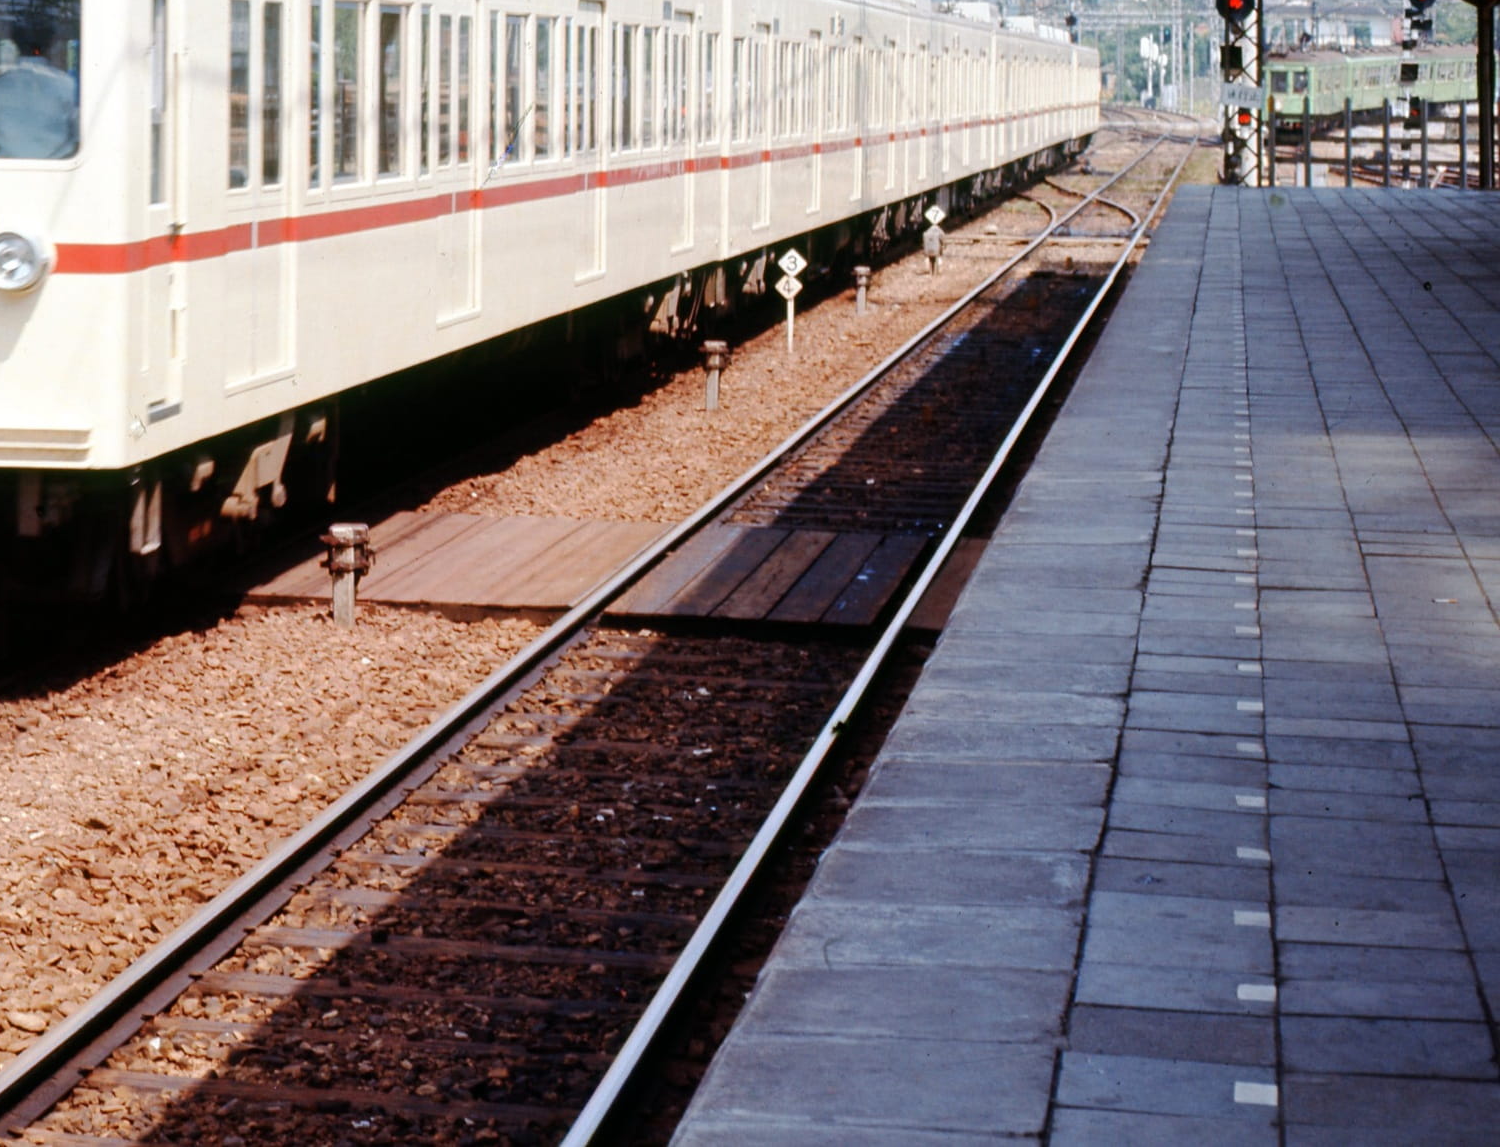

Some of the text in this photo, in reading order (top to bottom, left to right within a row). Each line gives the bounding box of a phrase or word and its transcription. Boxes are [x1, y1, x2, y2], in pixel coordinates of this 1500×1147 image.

[930, 209, 940, 221] 7
[786, 254, 798, 272] 3
[783, 280, 794, 294] 4
